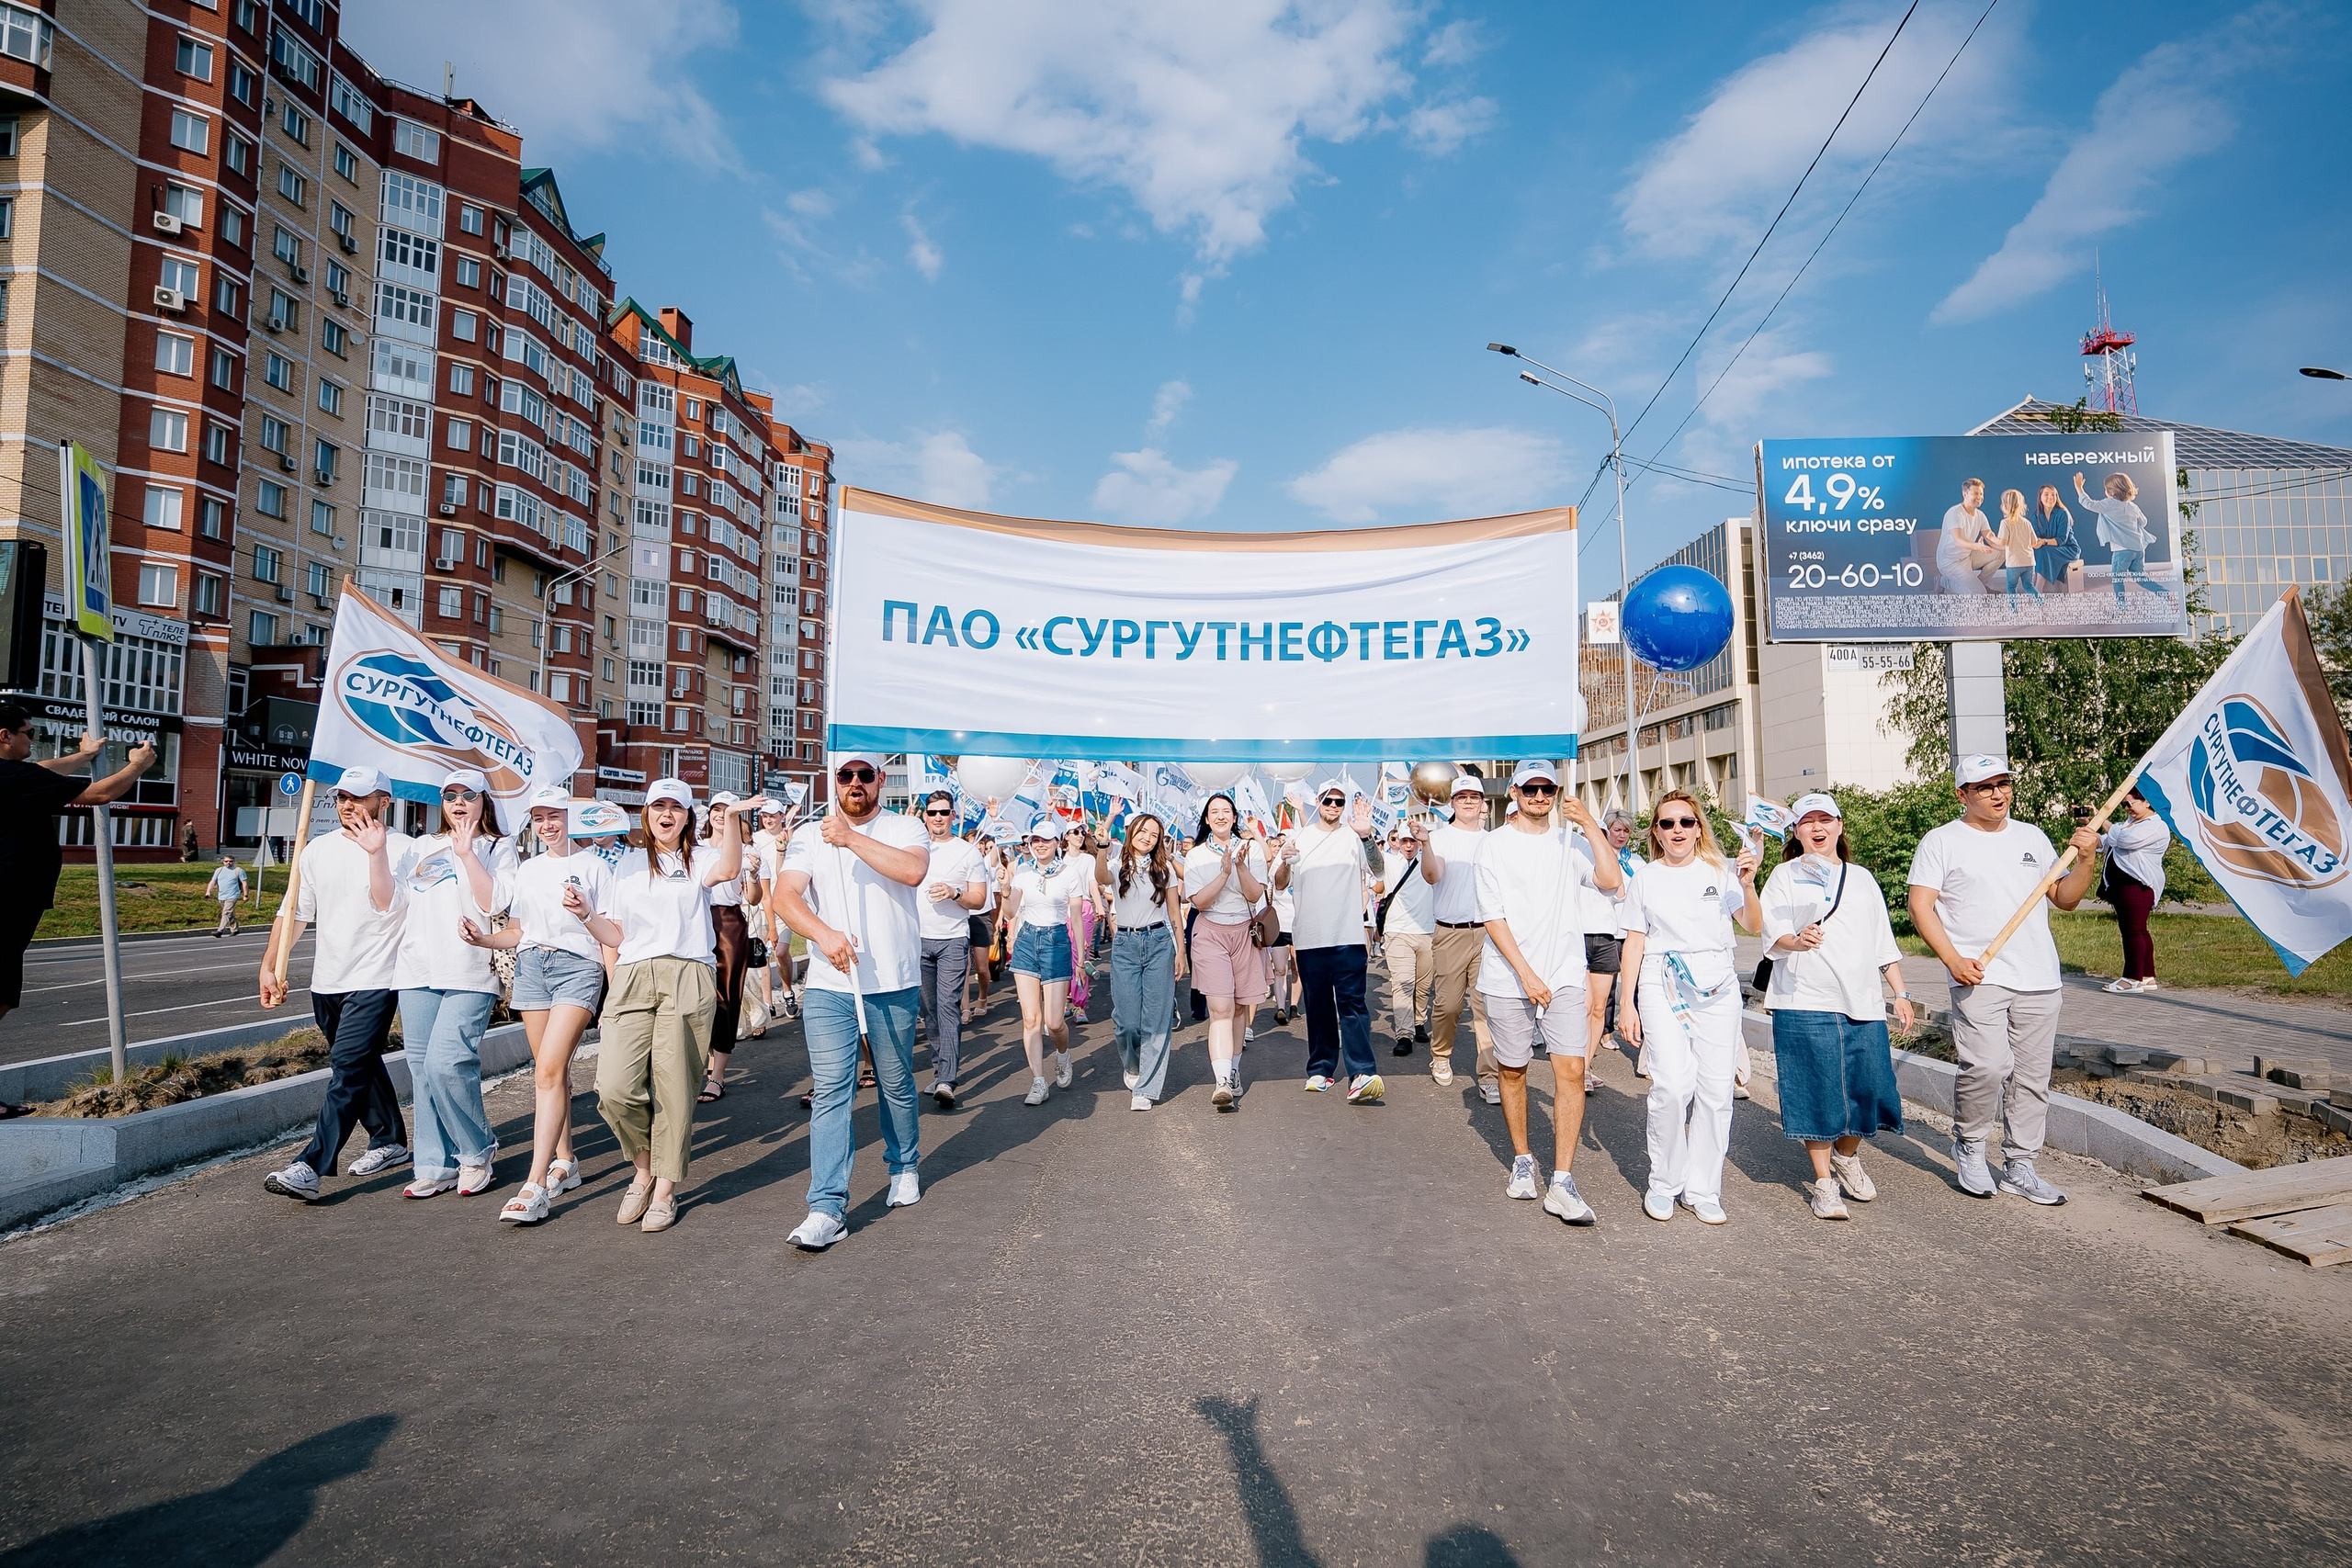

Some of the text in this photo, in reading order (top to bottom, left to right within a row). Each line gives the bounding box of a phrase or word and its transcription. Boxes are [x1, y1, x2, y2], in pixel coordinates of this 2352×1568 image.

[1782, 455, 1895, 469] ипотека от
[2025, 446, 2155, 465] набережный
[1784, 473, 1885, 514] 4,9%
[1785, 517, 1917, 536] ключи сразу
[1799, 551, 1825, 561] (3462)
[1788, 562, 1924, 589] 20-60-10
[152, 630, 183, 643] ПЛЮС
[162, 624, 186, 636] ТЕЛЕ
[881, 598, 1532, 663] ПАО «СУРГУТНЕФТЕГАЗ»
[1829, 649, 1858, 660] 400А
[1862, 655, 1911, 669] 55-55-66
[45, 705, 160, 727] СВАДЕЫЙ САЛОН
[345, 671, 534, 777] СУРГУТНЕФТЕГАЗ
[108, 728, 157, 746] NOVA
[232, 750, 309, 770] WHITE NOV
[2203, 712, 2340, 874] СУРГУТНЕФТЕГАЗ
